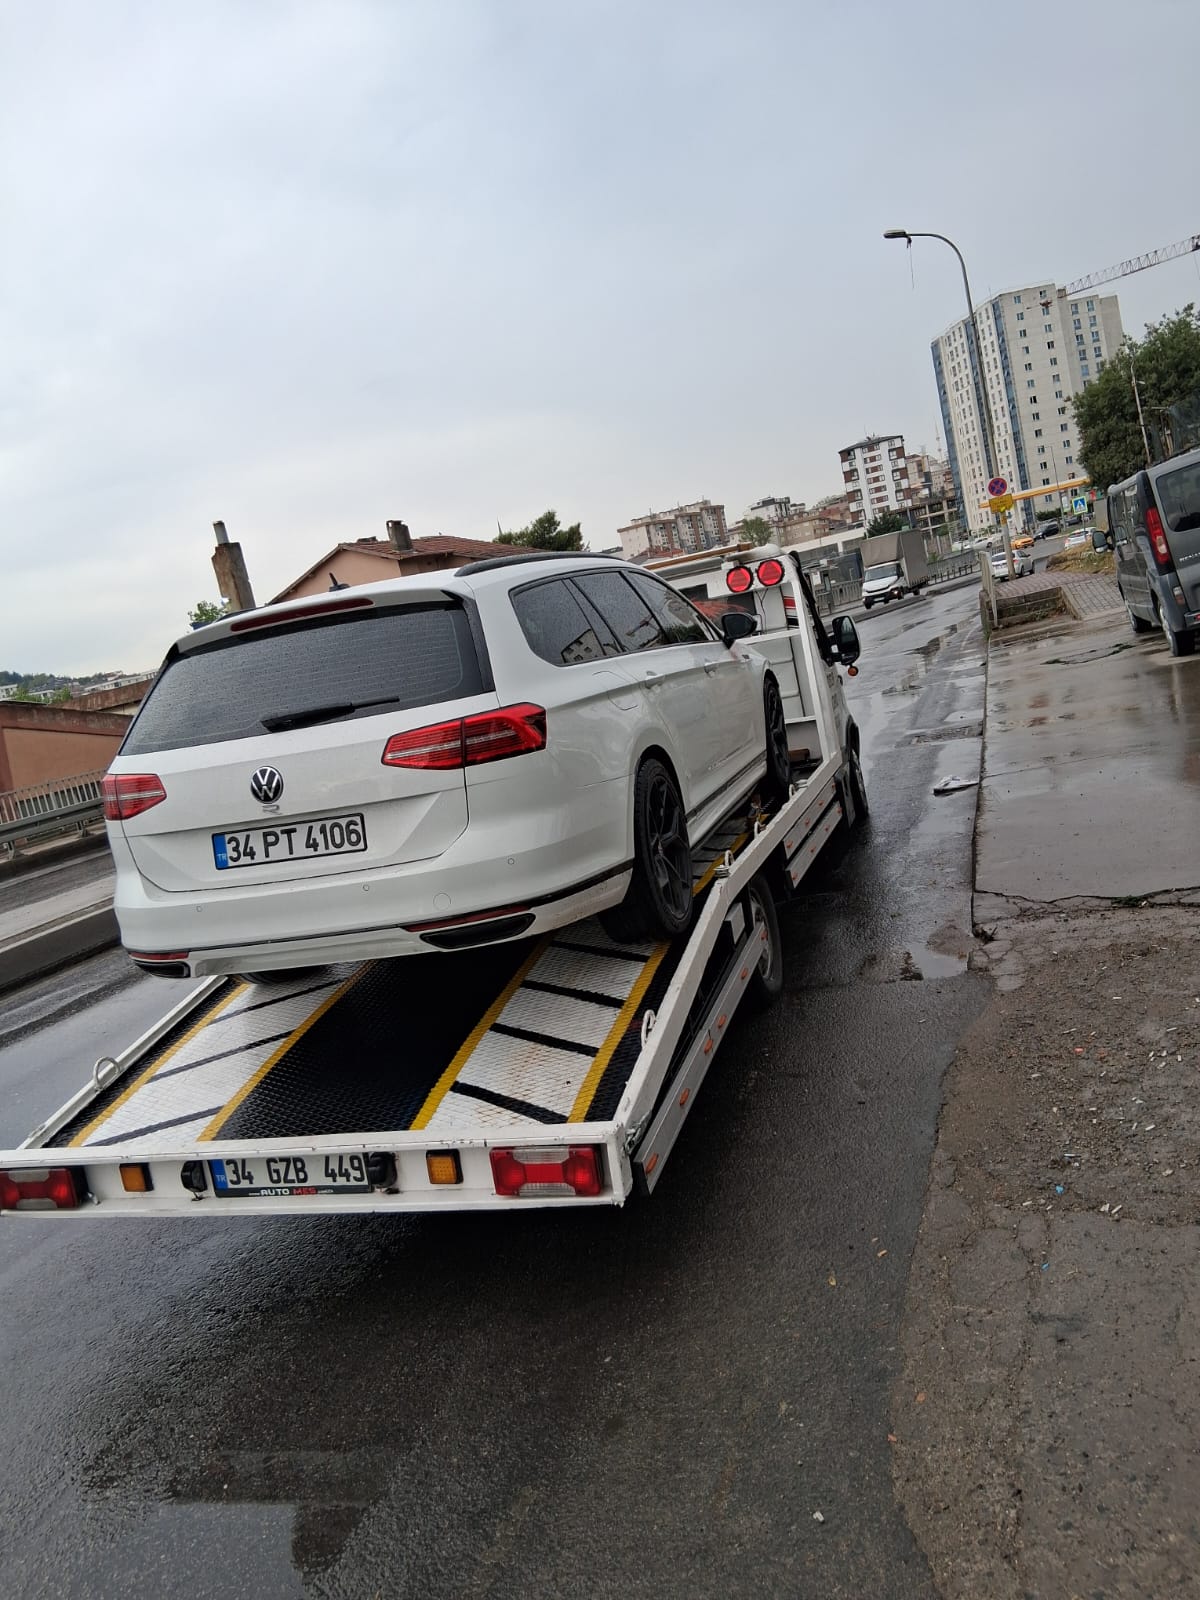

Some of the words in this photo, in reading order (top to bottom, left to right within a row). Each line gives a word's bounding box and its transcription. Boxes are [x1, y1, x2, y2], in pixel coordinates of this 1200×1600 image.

[226, 834, 256, 863] 34
[262, 827, 297, 858] PT
[305, 819, 362, 852] 4106
[216, 853, 227, 862] TR
[225, 1158, 254, 1186] 34
[266, 1156, 309, 1184] GZB
[324, 1155, 365, 1183] 449
[216, 1174, 226, 1183] TR
[260, 1188, 290, 1197] AUTO
[292, 1187, 316, 1196] MES
